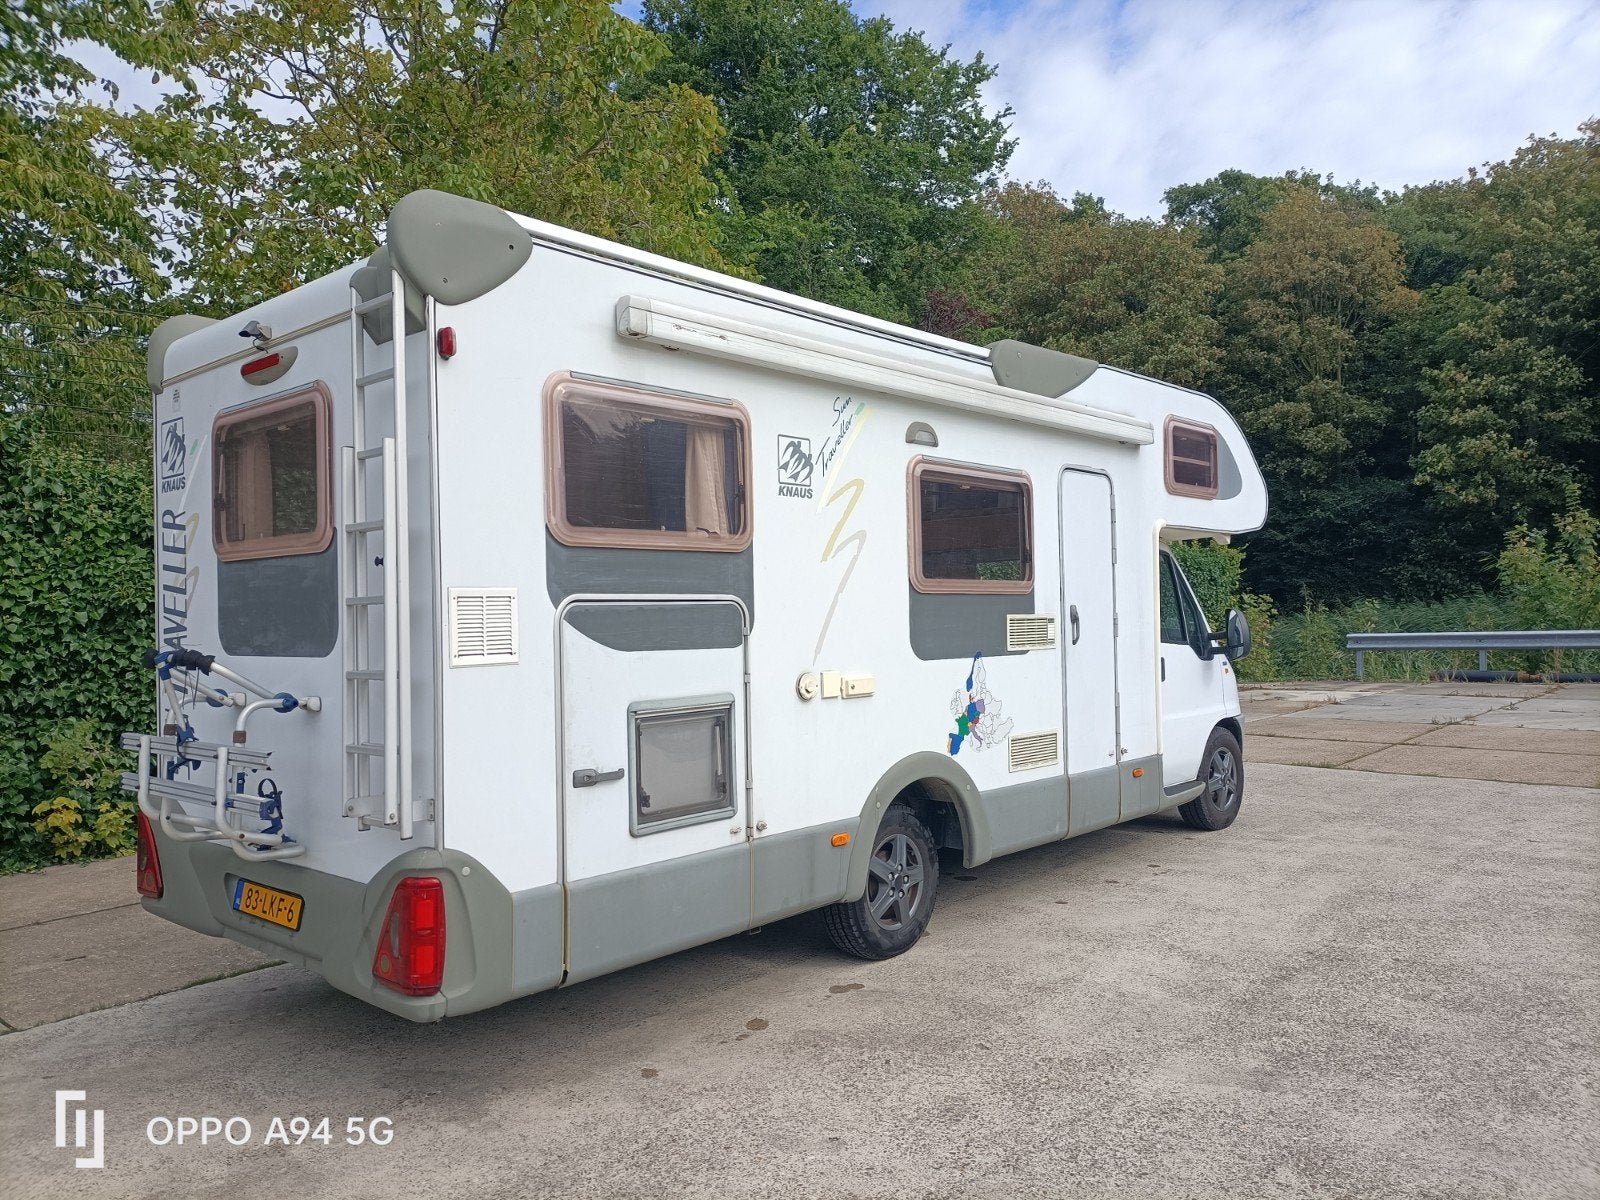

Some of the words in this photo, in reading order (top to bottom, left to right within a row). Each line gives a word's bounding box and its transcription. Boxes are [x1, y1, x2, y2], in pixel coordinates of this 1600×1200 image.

[832, 396, 852, 428] Sun
[814, 413, 854, 478] Traveller
[161, 477, 186, 493] KNAUS
[778, 485, 813, 499] KNAUS
[161, 508, 188, 696] AVELLER
[245, 887, 295, 923] 83-LKF-6
